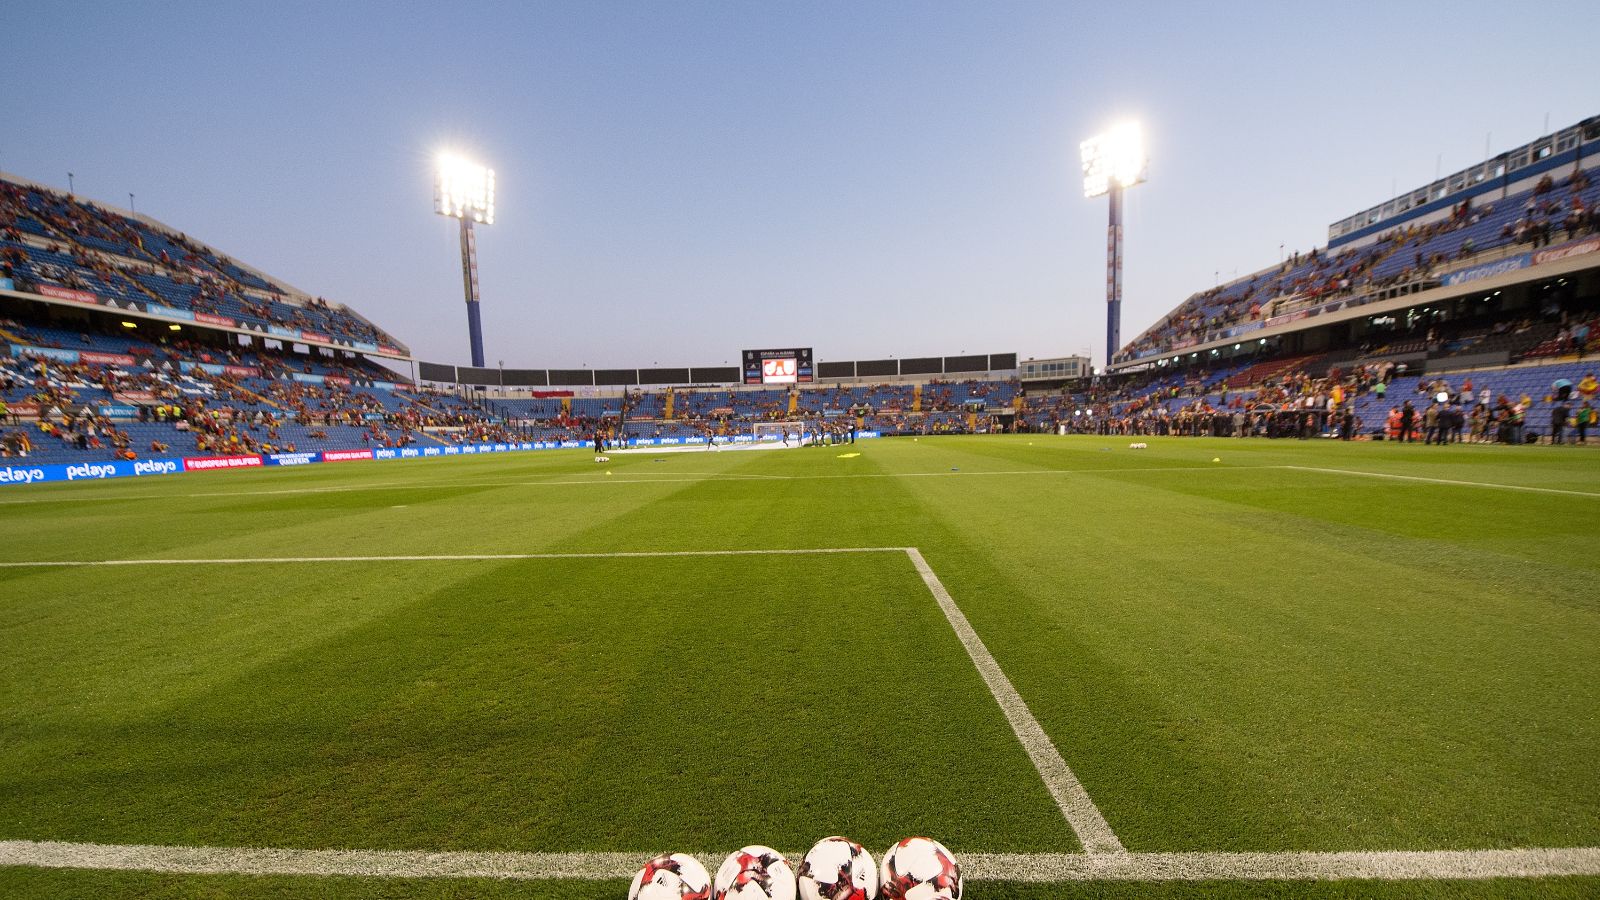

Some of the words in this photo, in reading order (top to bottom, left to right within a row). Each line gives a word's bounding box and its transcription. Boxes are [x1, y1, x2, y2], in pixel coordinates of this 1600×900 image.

[376, 449, 395, 459] pelayo
[401, 448, 418, 458] pelayo
[133, 460, 176, 476] pelayo
[194, 459, 228, 469] EUROPEAN
[228, 457, 261, 467] QUALIFIERS
[0, 467, 44, 483] elayo
[66, 463, 116, 480] pelayo
